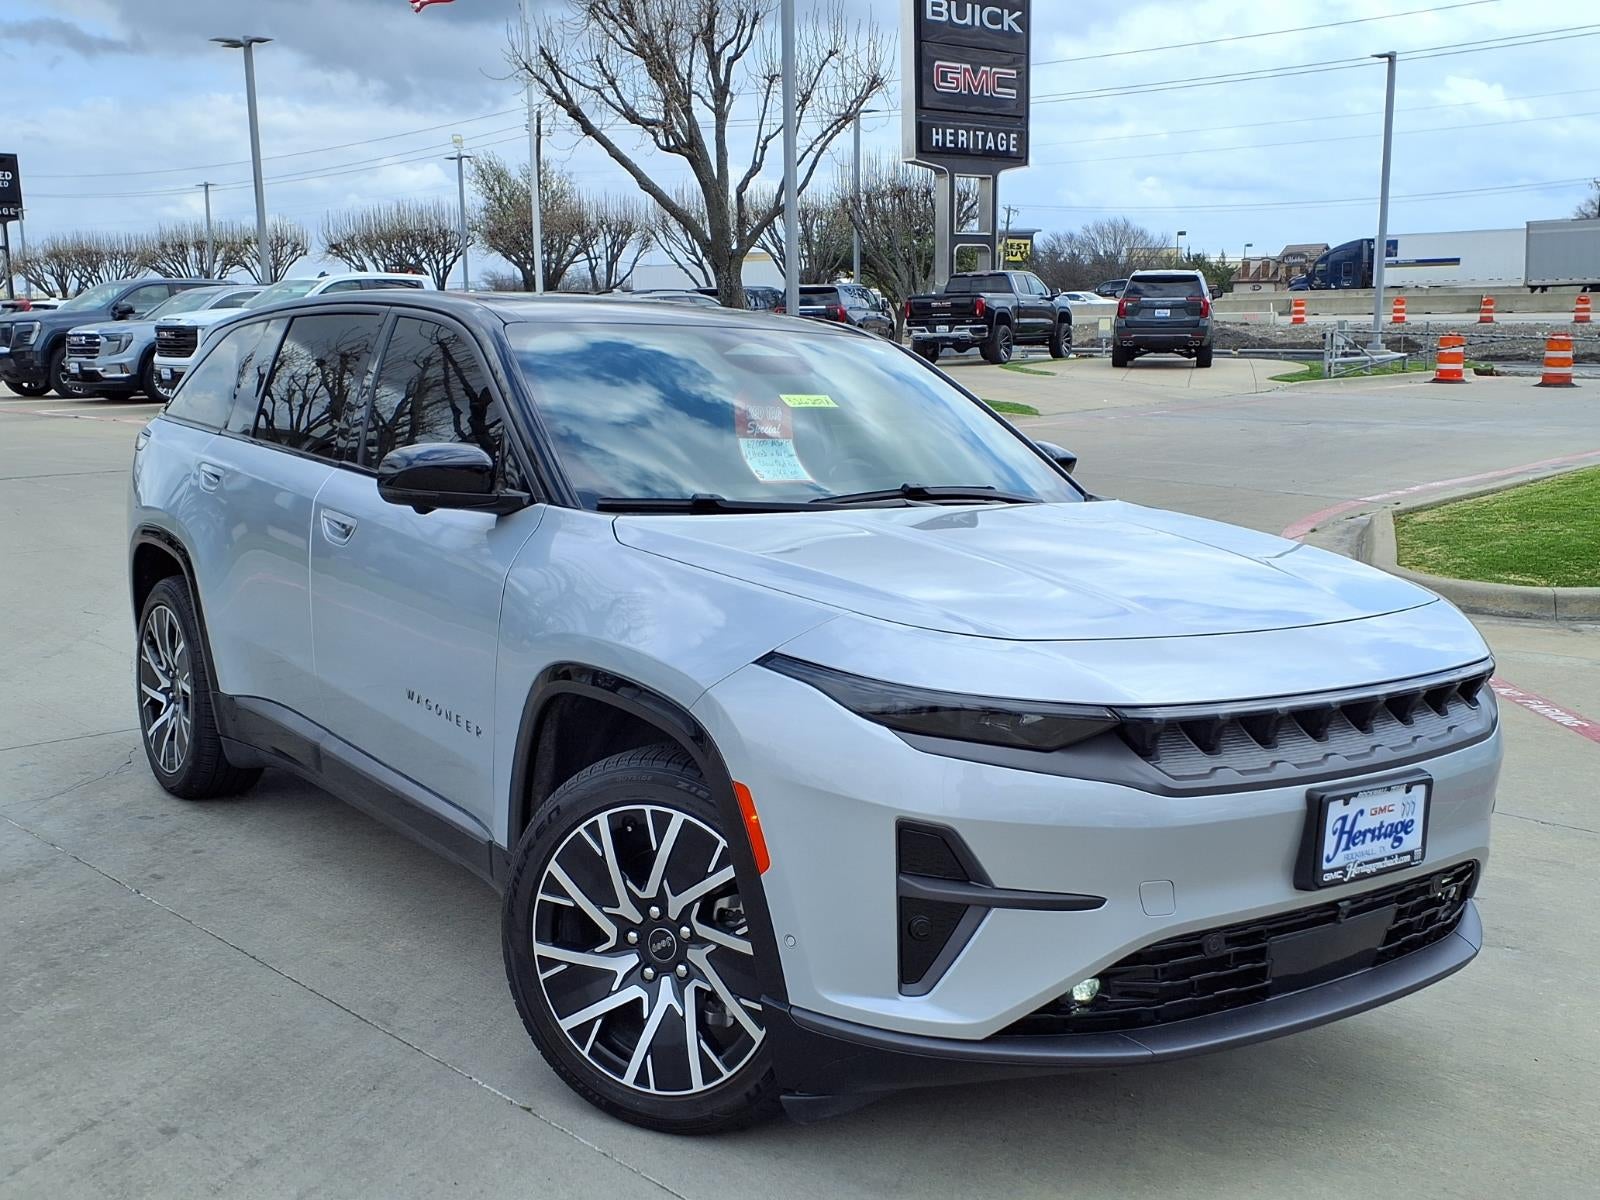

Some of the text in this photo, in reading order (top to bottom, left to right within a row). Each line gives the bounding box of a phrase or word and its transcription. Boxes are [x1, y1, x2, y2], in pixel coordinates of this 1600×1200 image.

[926, 0, 1024, 34] BUICK
[933, 60, 1018, 100] GMC
[932, 127, 1018, 153] HERITAGE
[746, 421, 782, 437] Special
[405, 688, 483, 738] WAGONEER
[1370, 803, 1396, 817] GMC
[1325, 808, 1415, 863] Heritage
[1323, 870, 1344, 882] GMC
